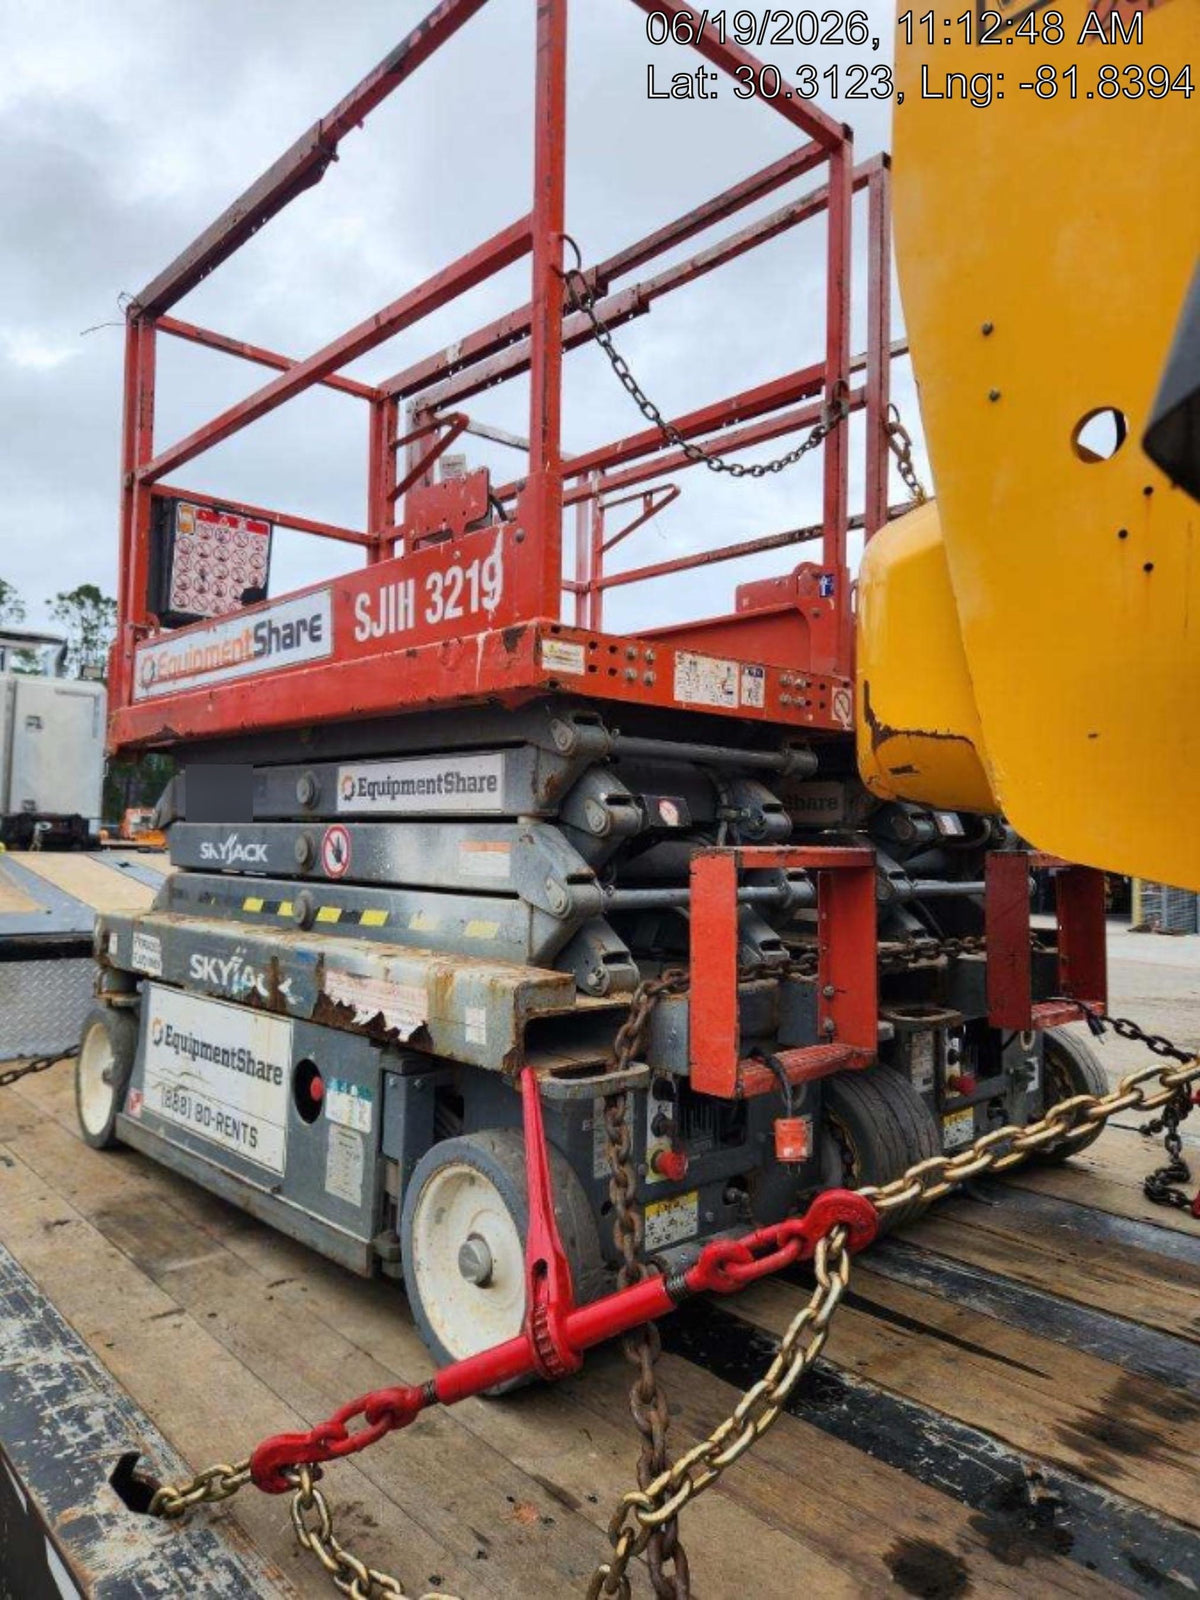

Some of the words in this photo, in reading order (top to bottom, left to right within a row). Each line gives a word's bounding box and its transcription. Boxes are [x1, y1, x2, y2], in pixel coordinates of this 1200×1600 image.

[425, 558, 504, 625] 3219
[157, 613, 323, 682] EquipmentShare
[357, 770, 498, 801] EquipmentShare
[200, 832, 269, 865] SKYJACK
[164, 1023, 284, 1086] EquipmentShare
[195, 1102, 258, 1148] 80-RENTS
